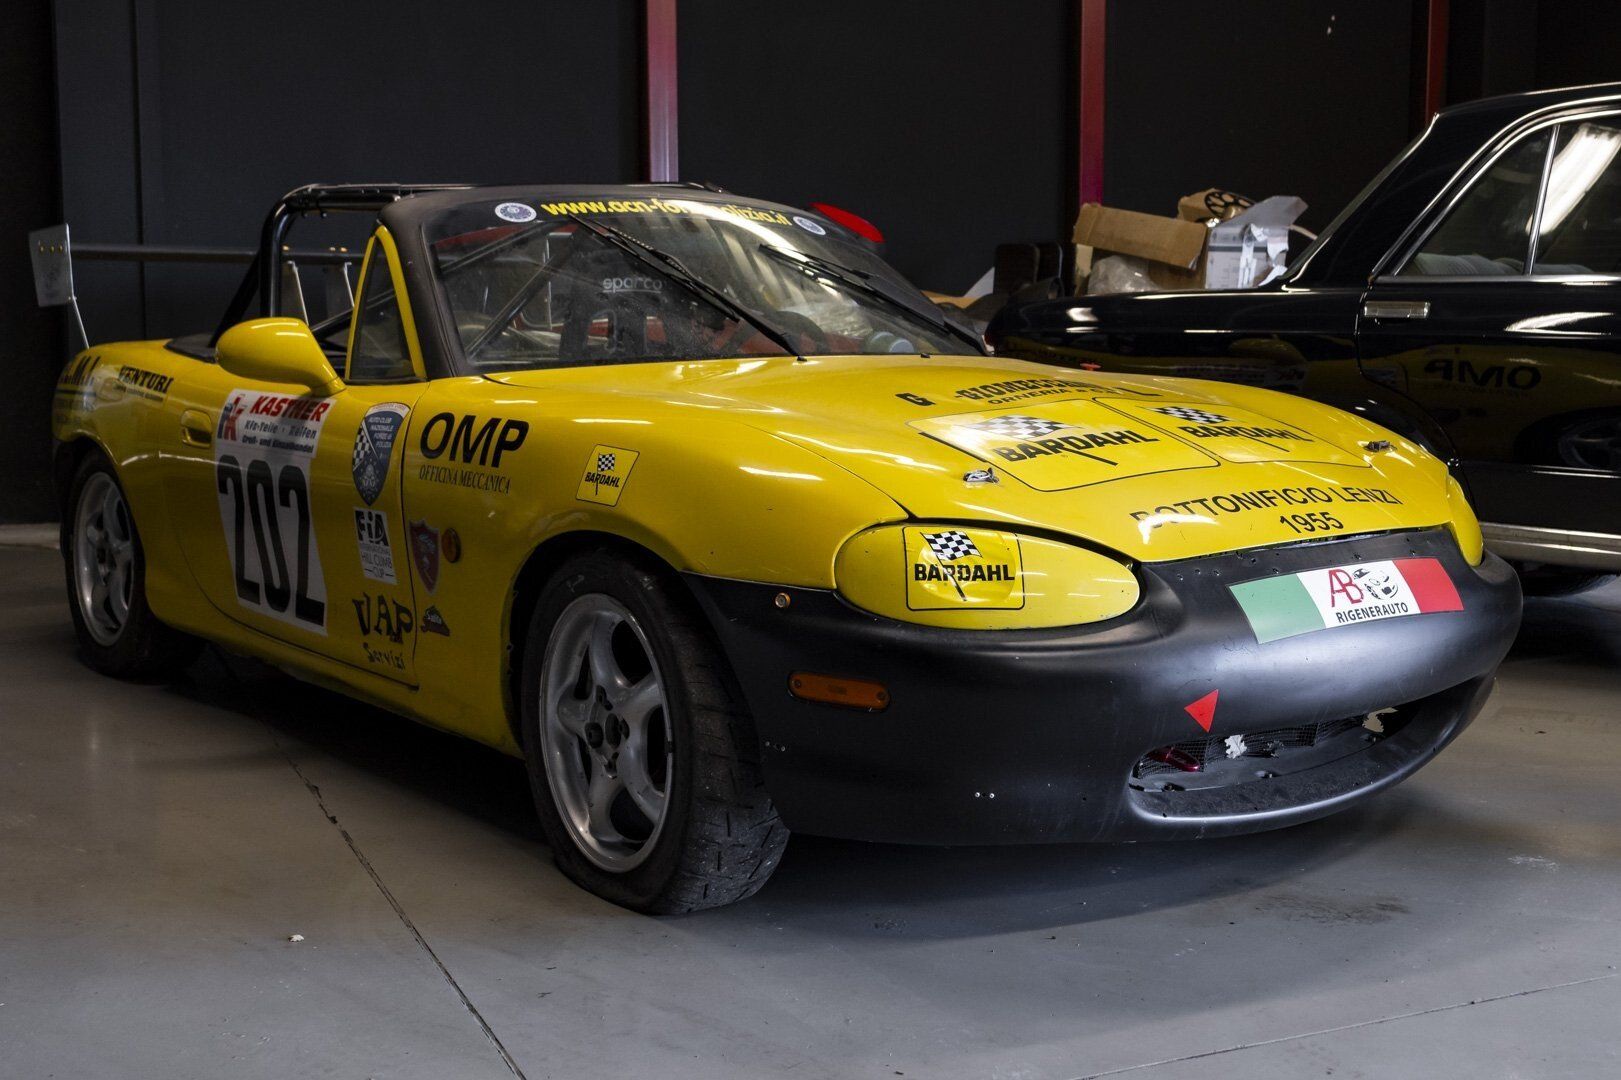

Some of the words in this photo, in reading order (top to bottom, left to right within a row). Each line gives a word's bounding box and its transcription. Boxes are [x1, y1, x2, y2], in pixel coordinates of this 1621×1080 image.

[602, 276, 663, 294] sparco
[119, 365, 174, 393] VENTURI
[249, 395, 331, 423] KASTNER
[419, 412, 530, 468] OMP
[1178, 425, 1317, 443] BARDAHL
[992, 429, 1161, 463] BARDAHL
[418, 464, 458, 486] OFFICINA
[458, 469, 512, 495] MECCANICA
[584, 471, 620, 488] BARDAHL
[1329, 487, 1404, 506] LENZI
[1279, 511, 1345, 534] 1955
[216, 454, 325, 627] 202
[913, 563, 1016, 581] BARDAHL
[1335, 601, 1409, 624] RIGENERAUTO
